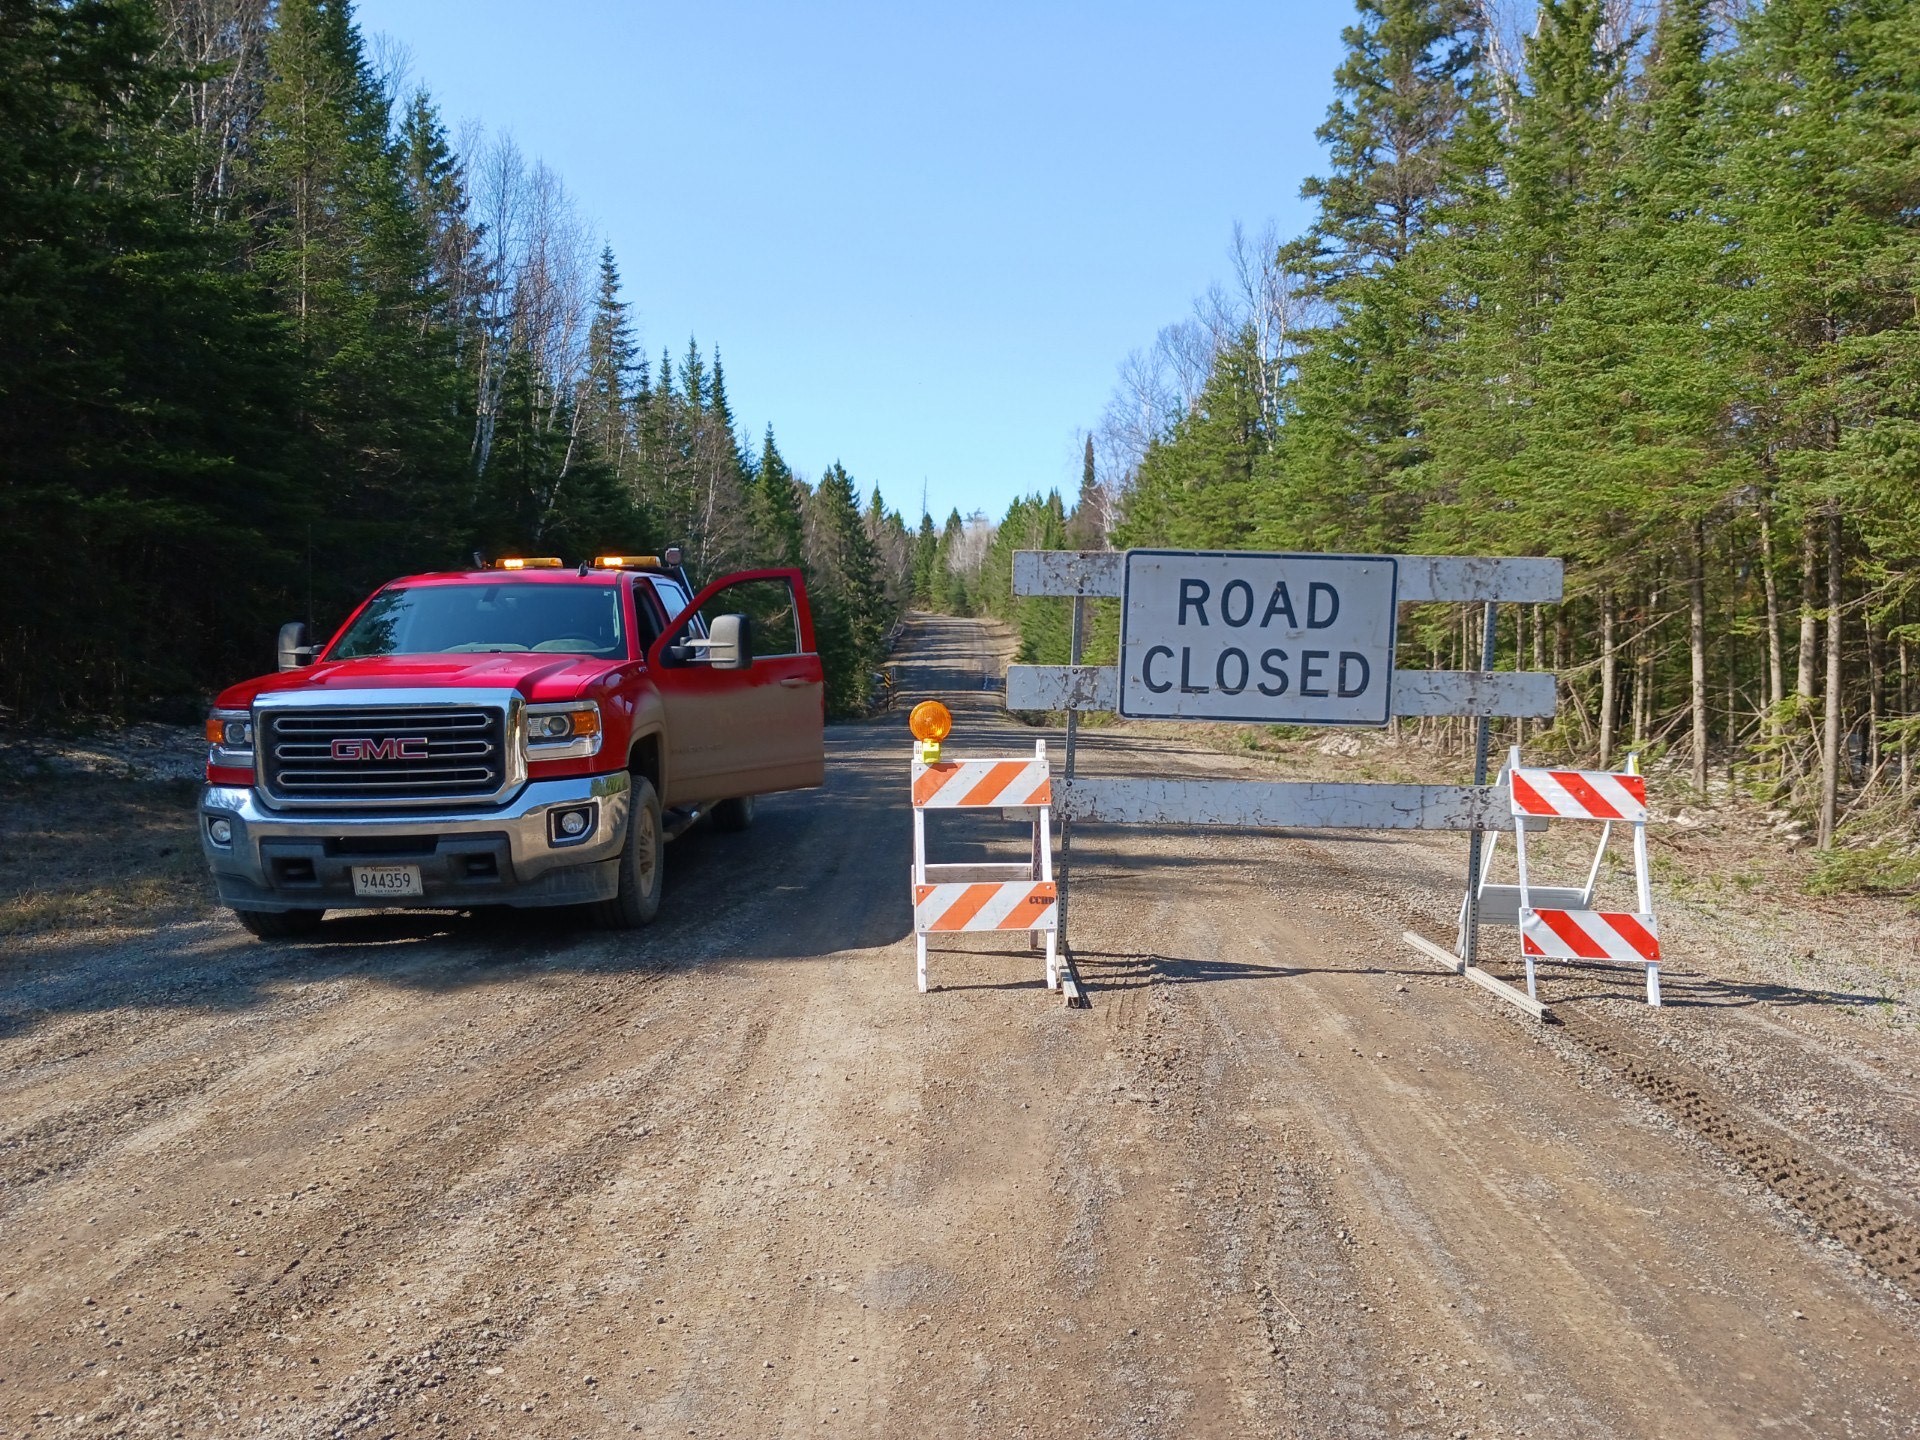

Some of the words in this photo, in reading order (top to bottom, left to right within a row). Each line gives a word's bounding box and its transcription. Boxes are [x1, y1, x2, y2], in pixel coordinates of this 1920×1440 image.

[1178, 578, 1340, 629] ROAD
[1142, 645, 1370, 698] CLOSED
[331, 737, 428, 760] GMC
[360, 873, 410, 888] 944359
